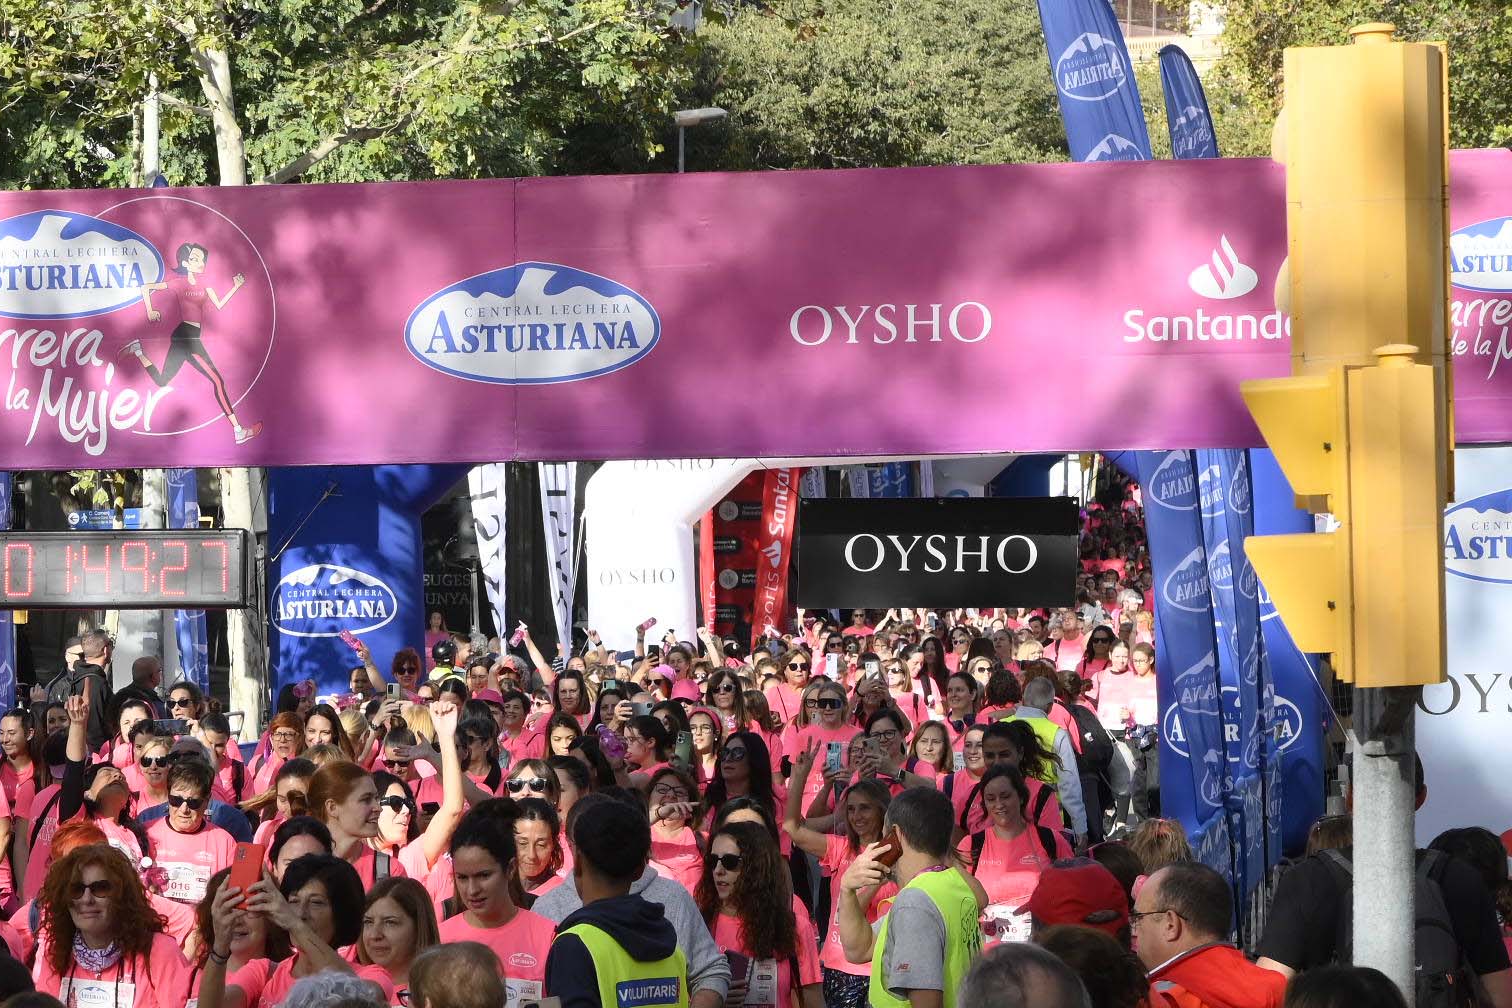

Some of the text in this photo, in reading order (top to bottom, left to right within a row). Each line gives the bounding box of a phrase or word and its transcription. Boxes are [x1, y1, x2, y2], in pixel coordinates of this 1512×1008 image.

[424, 309, 641, 354] ASTURIANA
[464, 304, 633, 318] CENTRAL LECHERA
[790, 301, 993, 346] OYSHO
[5, 373, 29, 411] la
[24, 363, 173, 456] Mujer
[4, 541, 228, 597] 01:49:27
[844, 533, 1038, 573] OYSHO
[275, 594, 388, 621] ASTURIANA
